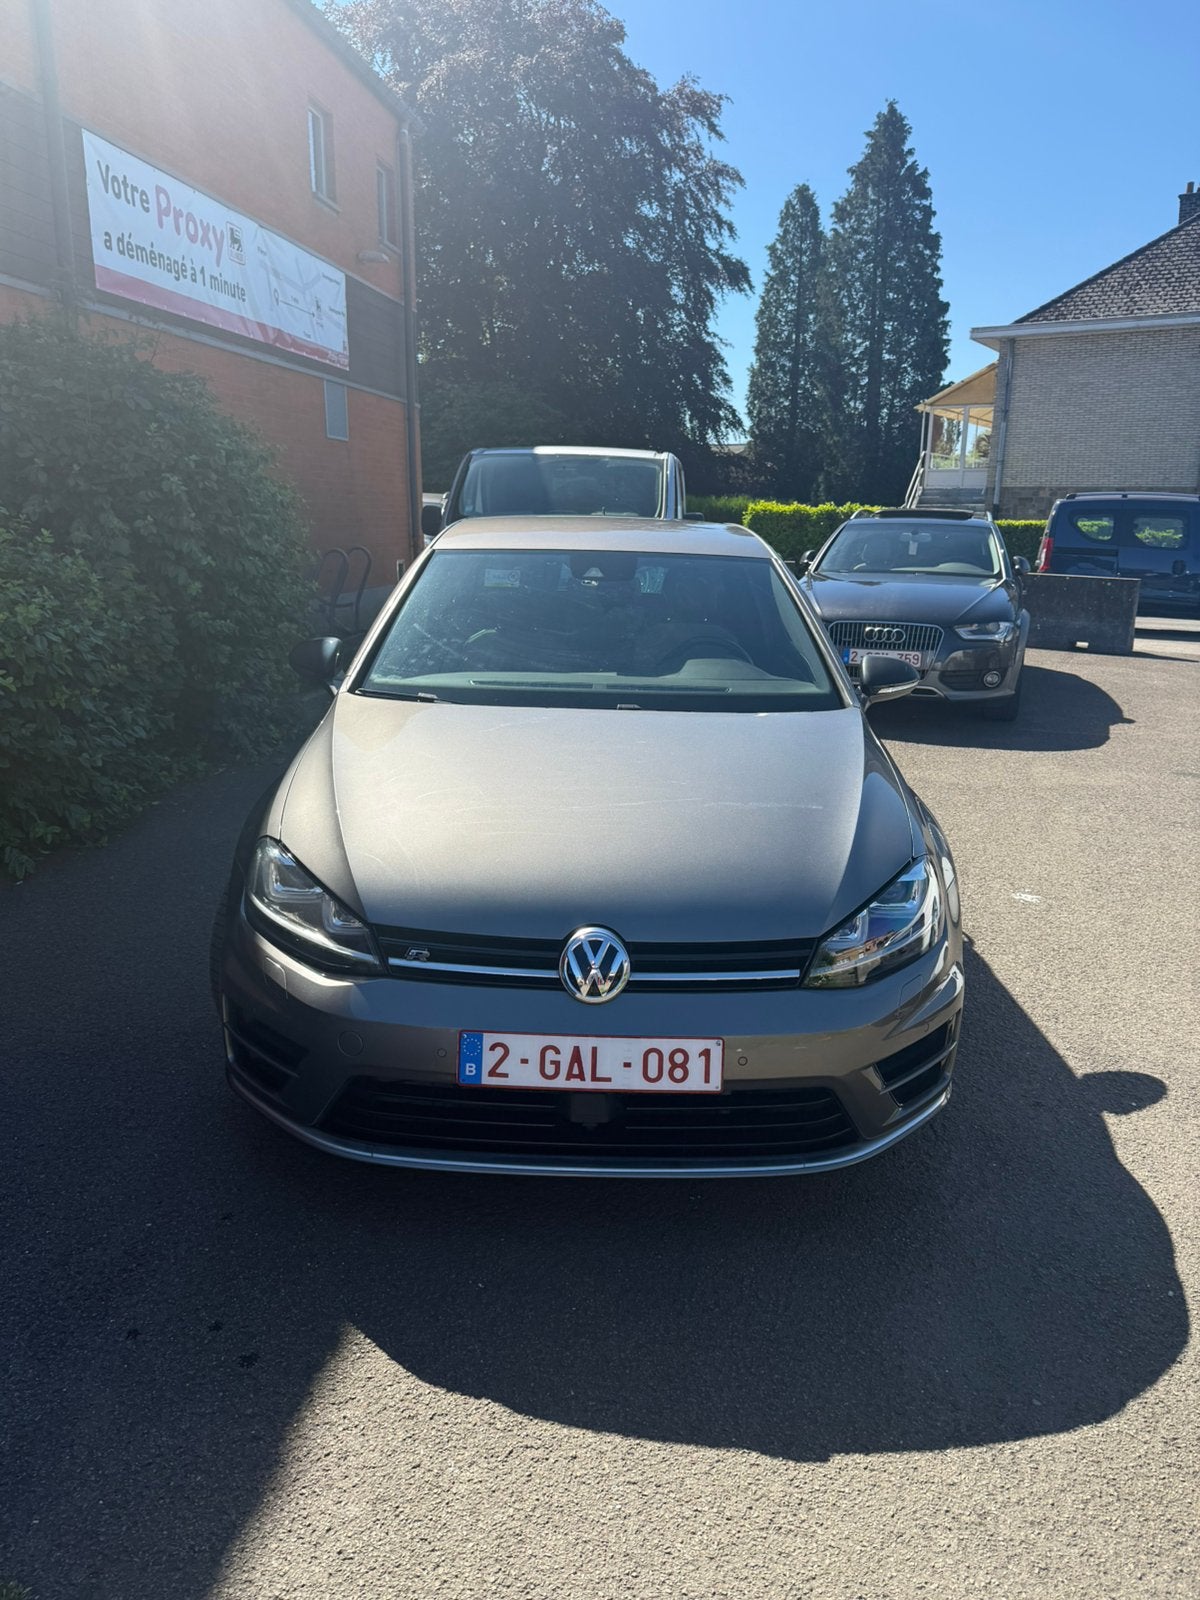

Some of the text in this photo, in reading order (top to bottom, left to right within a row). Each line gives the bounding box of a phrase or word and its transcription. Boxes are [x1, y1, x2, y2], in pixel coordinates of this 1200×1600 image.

[97, 160, 225, 268] Votre Proxy
[104, 231, 246, 302] a déménagé à 1 minute
[465, 1063, 476, 1076] B
